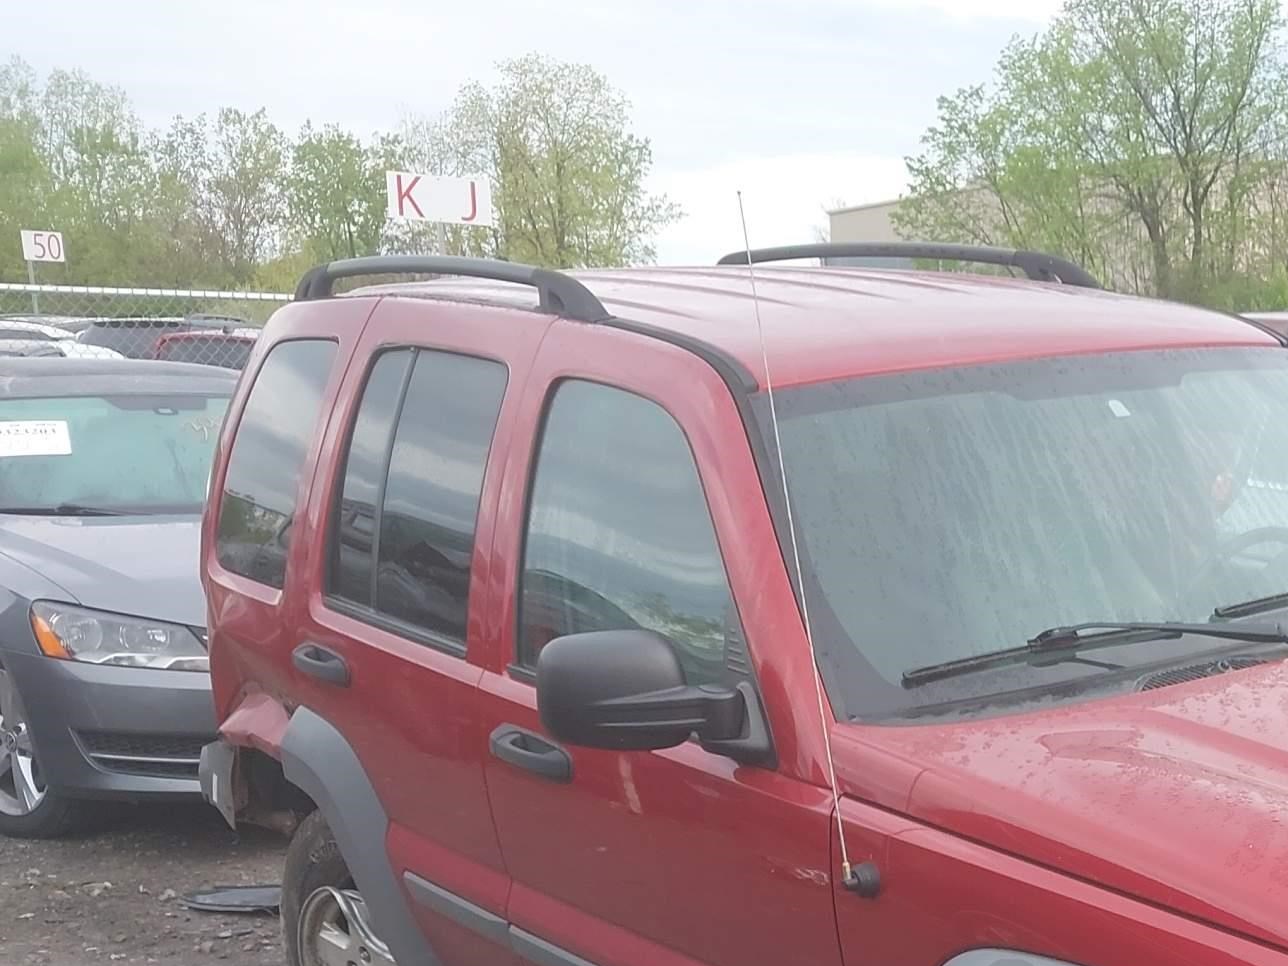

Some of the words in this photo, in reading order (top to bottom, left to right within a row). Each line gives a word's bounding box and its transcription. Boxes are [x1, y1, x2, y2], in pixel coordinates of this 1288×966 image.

[395, 174, 426, 219] K
[461, 181, 477, 221] J
[33, 232, 61, 260] 50
